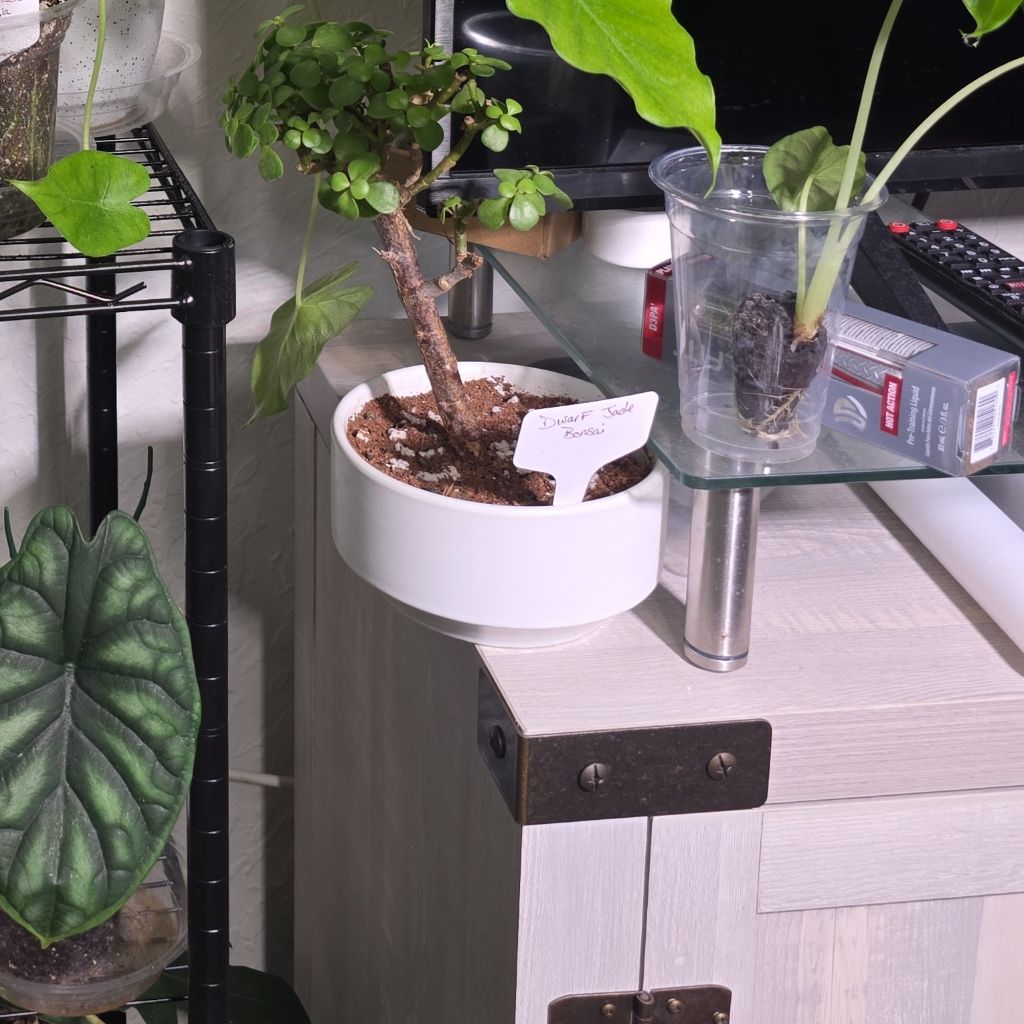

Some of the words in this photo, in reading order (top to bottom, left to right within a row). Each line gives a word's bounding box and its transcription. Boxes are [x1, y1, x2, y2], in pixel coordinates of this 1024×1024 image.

[887, 381, 897, 411] ACTION
[910, 385, 920, 406] Liquid
[602, 401, 634, 419] Jade
[885, 410, 894, 429] HOT
[561, 423, 605, 439] Bonsai
[906, 406, 918, 445] Pre-Training
